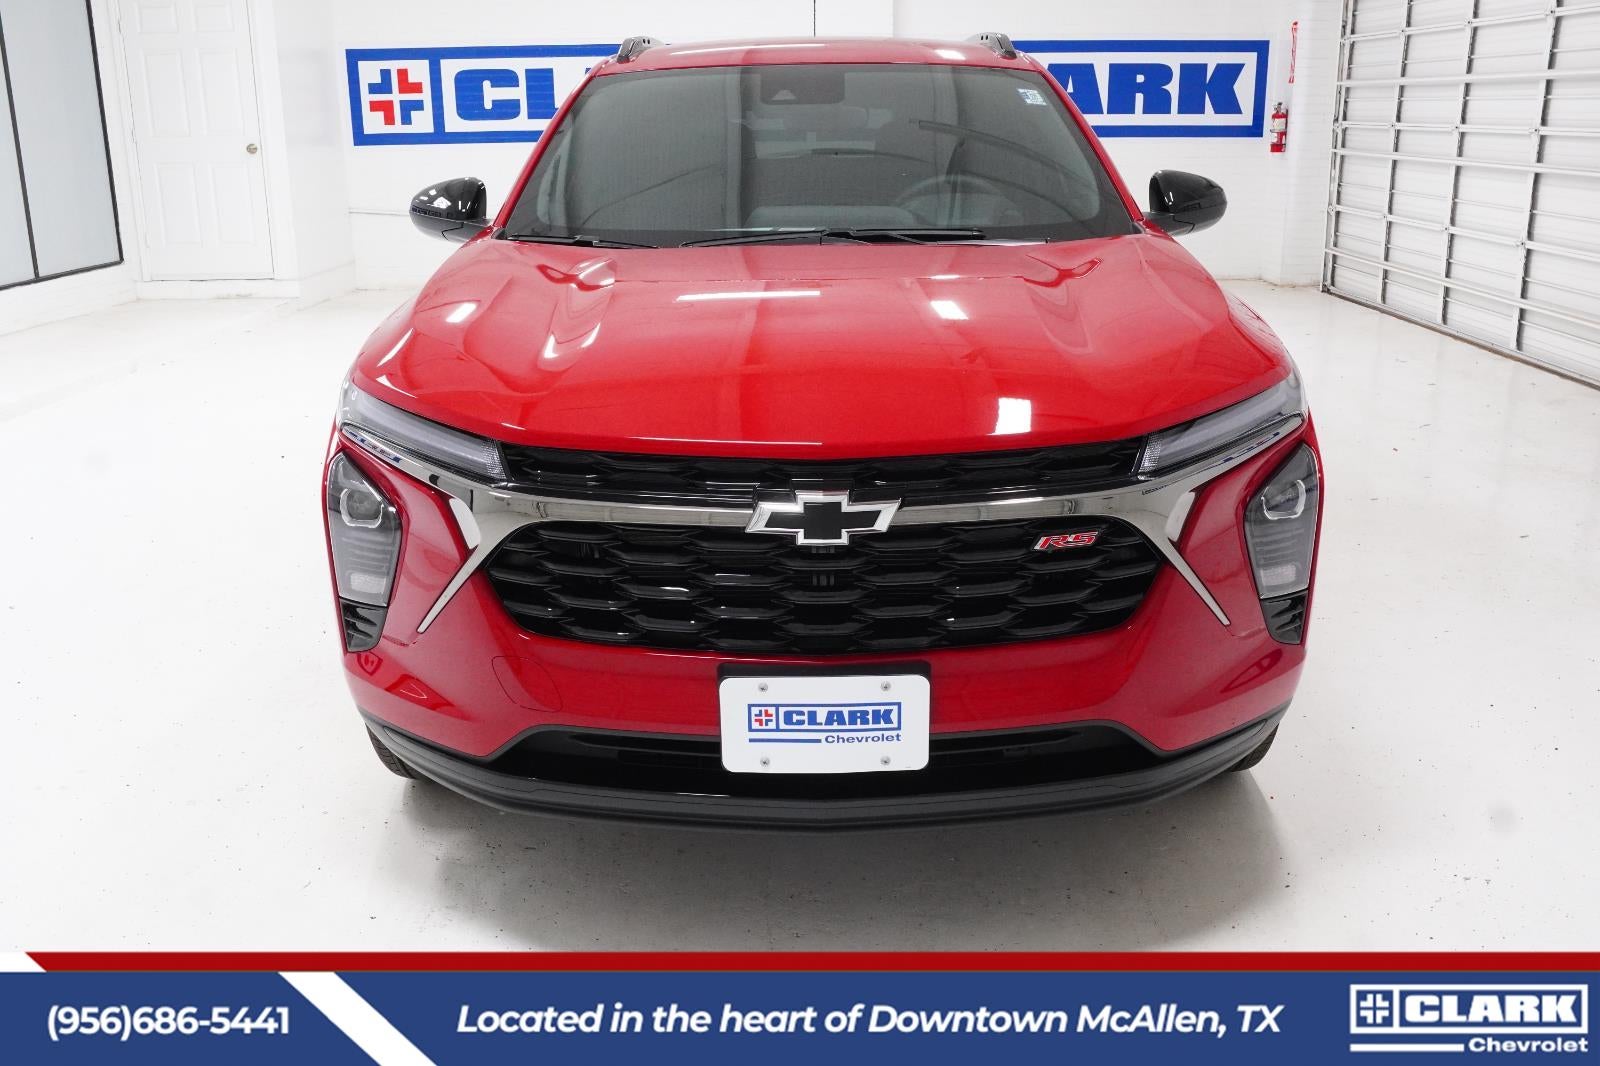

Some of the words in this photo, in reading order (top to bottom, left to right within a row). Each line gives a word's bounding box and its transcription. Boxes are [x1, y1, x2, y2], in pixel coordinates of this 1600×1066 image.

[1033, 531, 1098, 550] RS
[783, 708, 895, 726] CLARK
[824, 733, 902, 744] Chevrolet
